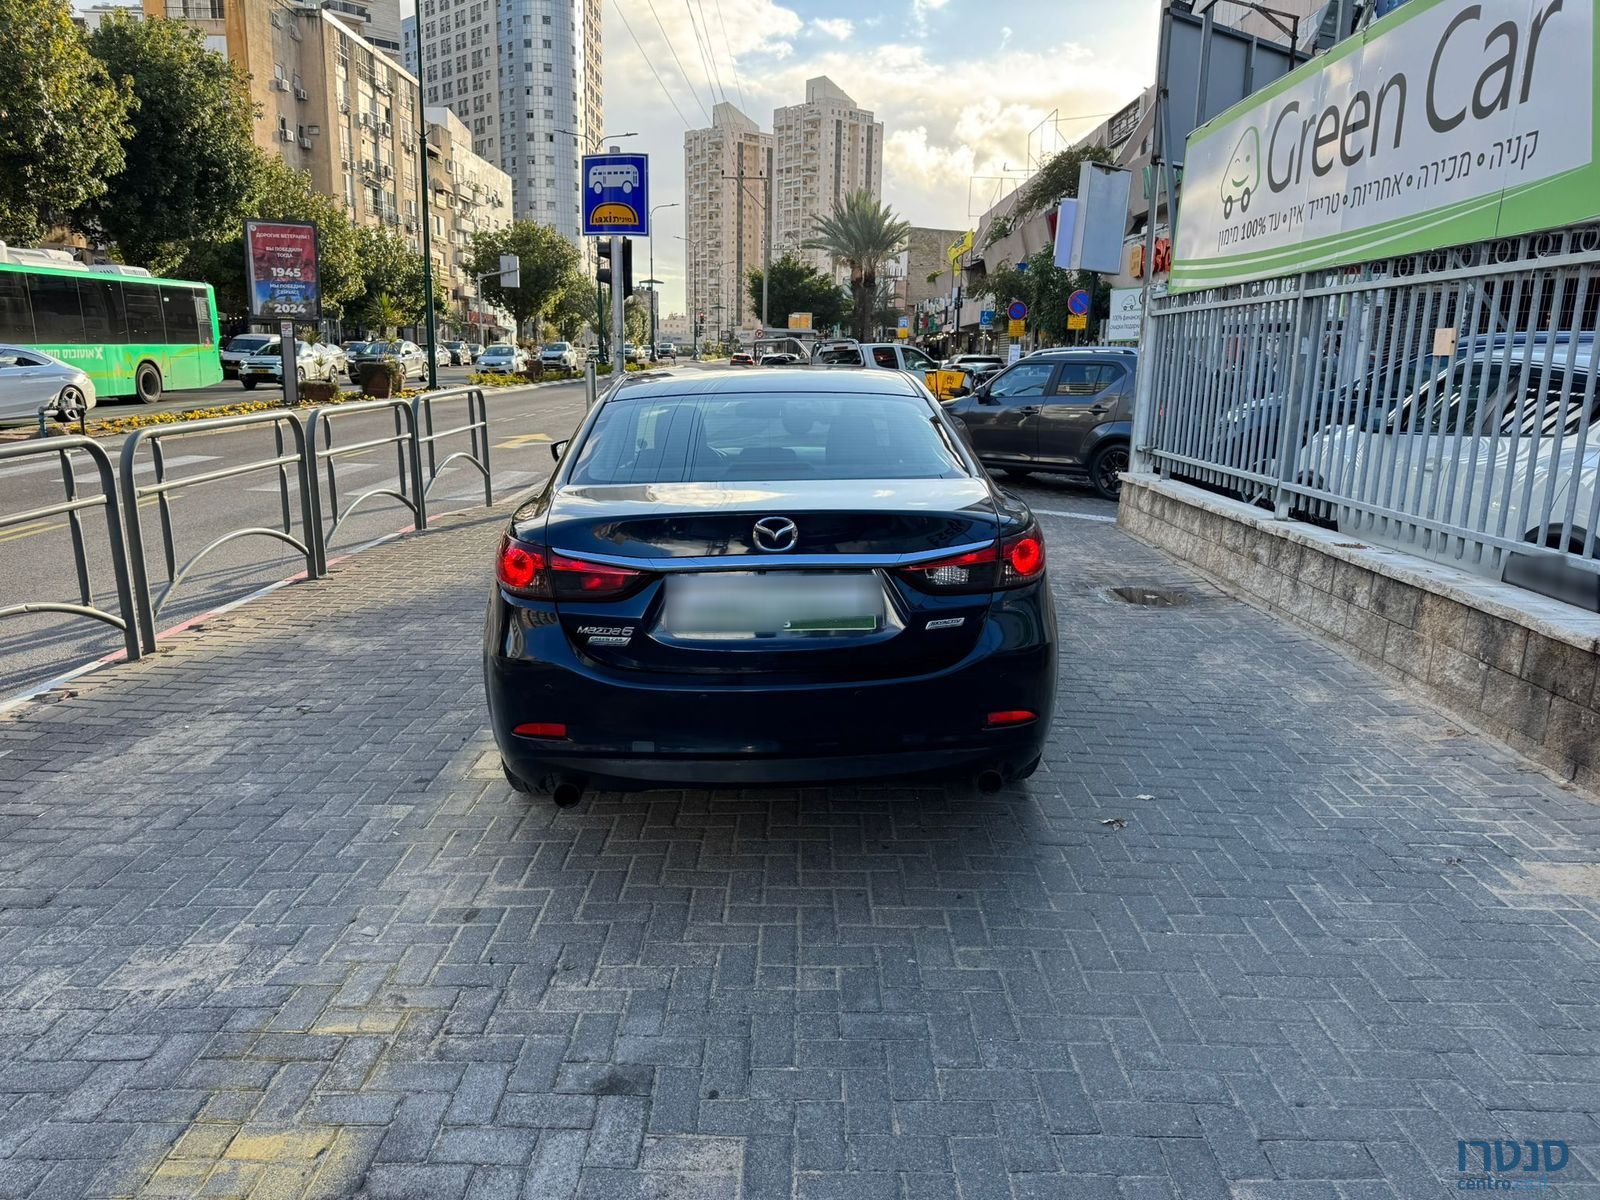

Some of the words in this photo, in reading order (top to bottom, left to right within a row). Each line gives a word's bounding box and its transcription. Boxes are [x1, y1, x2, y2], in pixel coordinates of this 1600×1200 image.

[1267, 73, 1407, 195] Green
[1425, 0, 1562, 133] Car
[1489, 130, 1540, 171] קניה
[1417, 151, 1471, 190] מכירה
[1350, 173, 1404, 209] אחריות
[1288, 203, 1303, 232] אין
[1308, 192, 1341, 221] טרייד
[1241, 217, 1266, 241] 100%
[1267, 212, 1280, 233] עד
[1217, 225, 1239, 253] מימון
[271, 267, 301, 277] 1945
[274, 304, 306, 313] 2024
